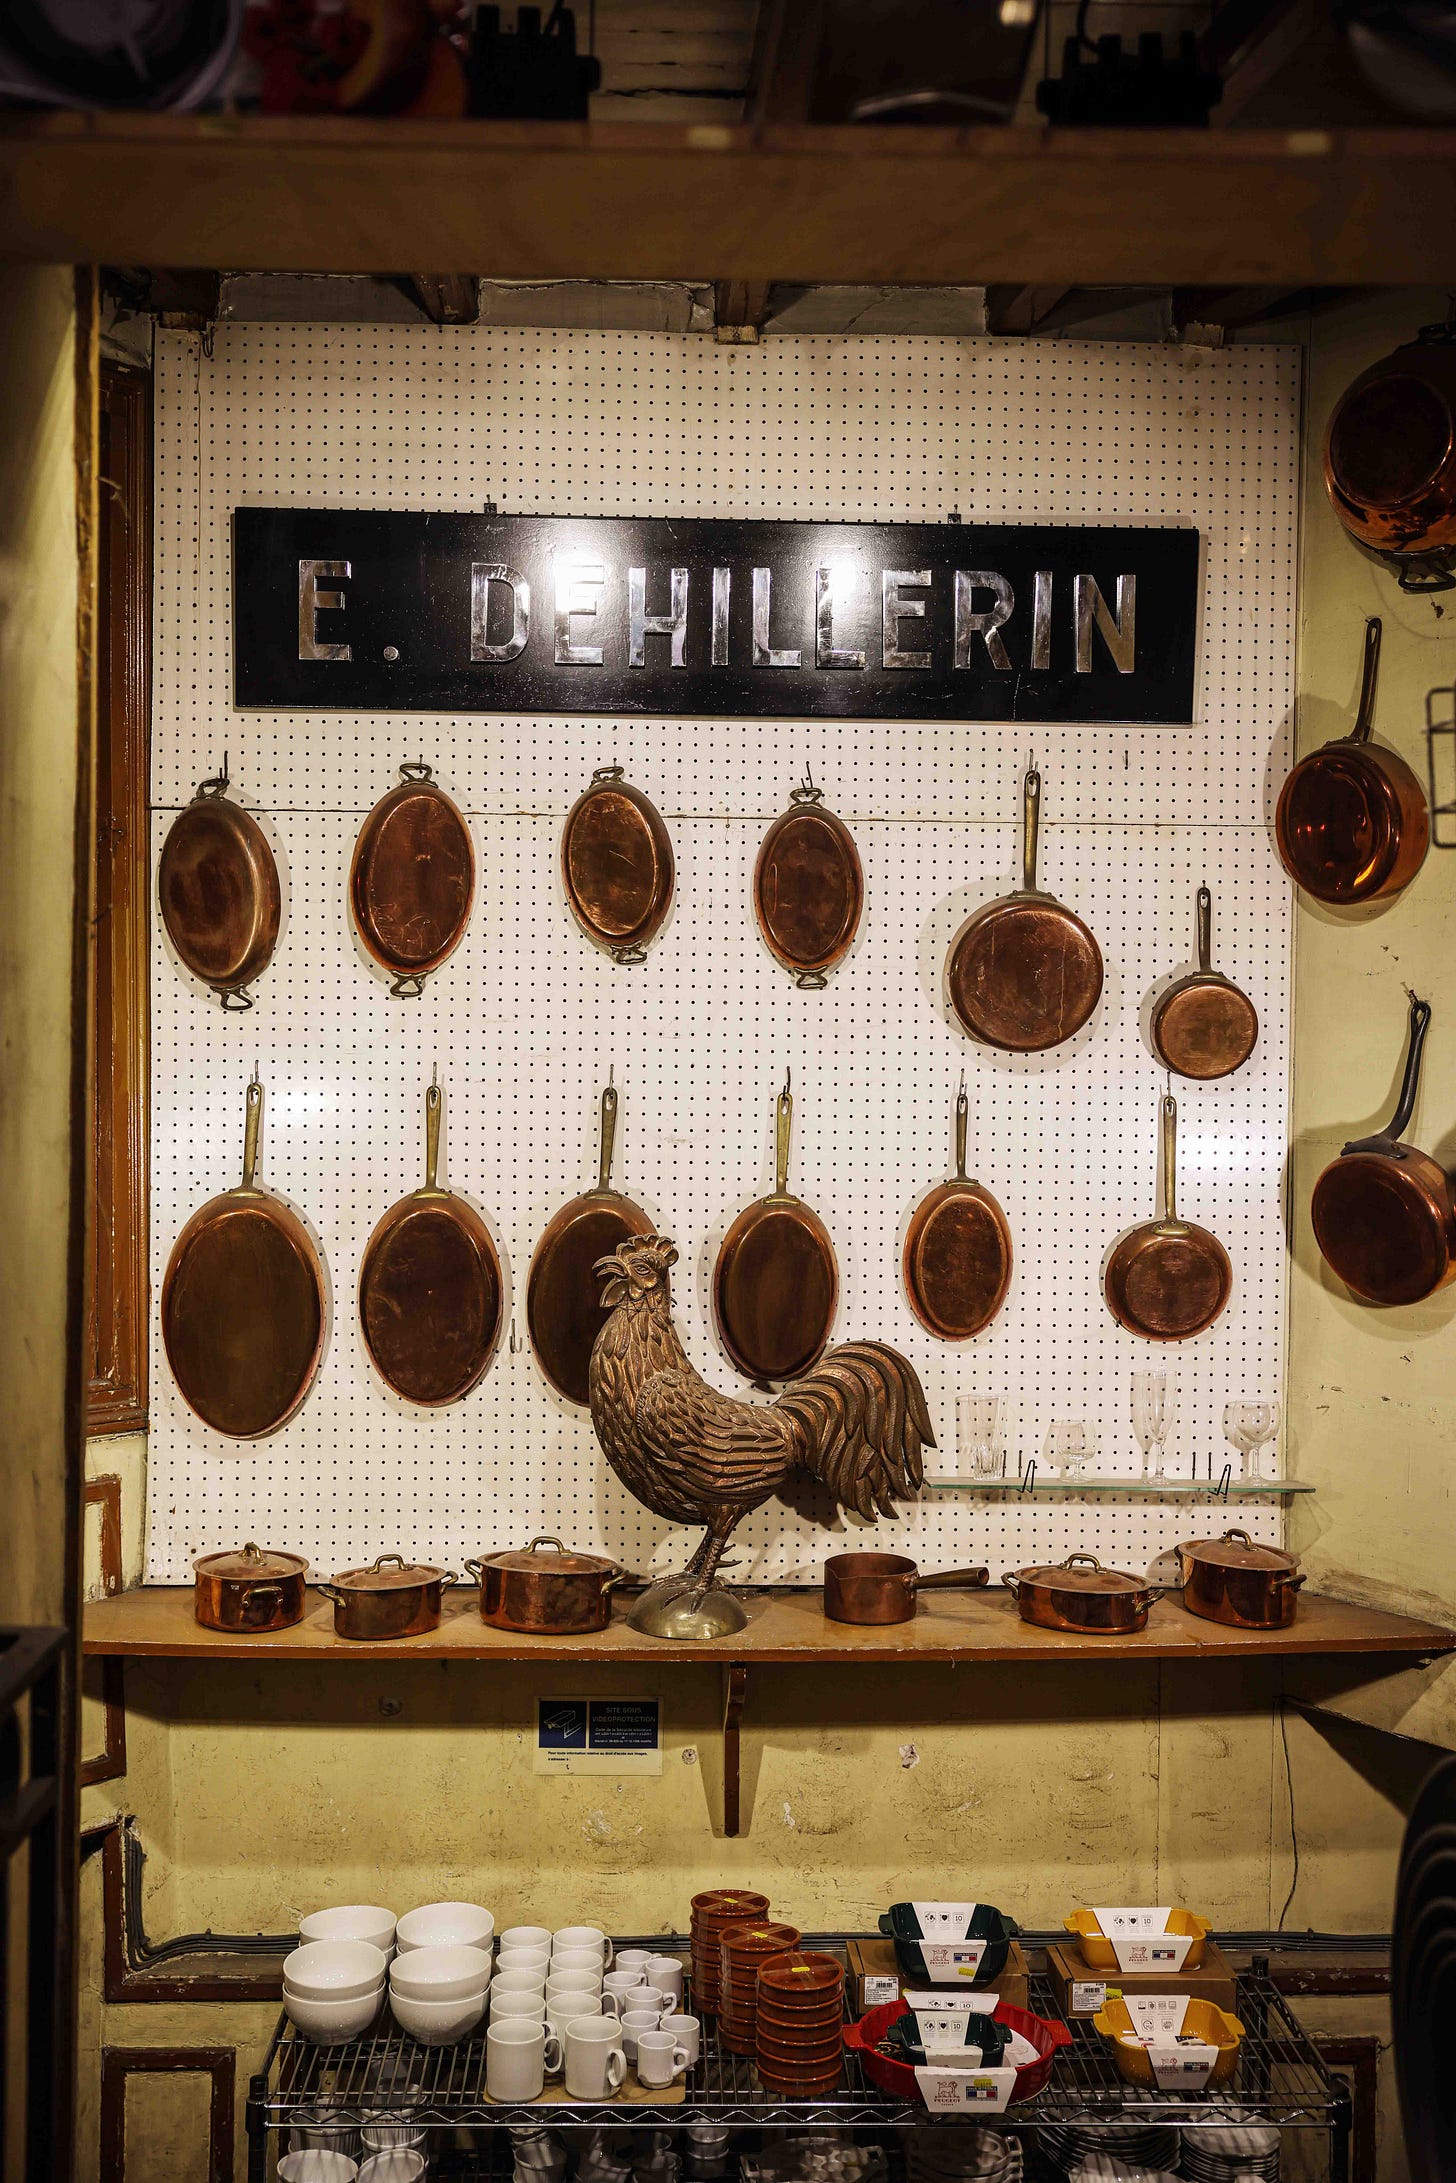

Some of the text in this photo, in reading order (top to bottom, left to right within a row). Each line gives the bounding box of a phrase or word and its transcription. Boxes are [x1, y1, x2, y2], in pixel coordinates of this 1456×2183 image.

[298, 559, 1136, 674] E. DEHILLERIN
[955, 1914, 963, 1922] 10
